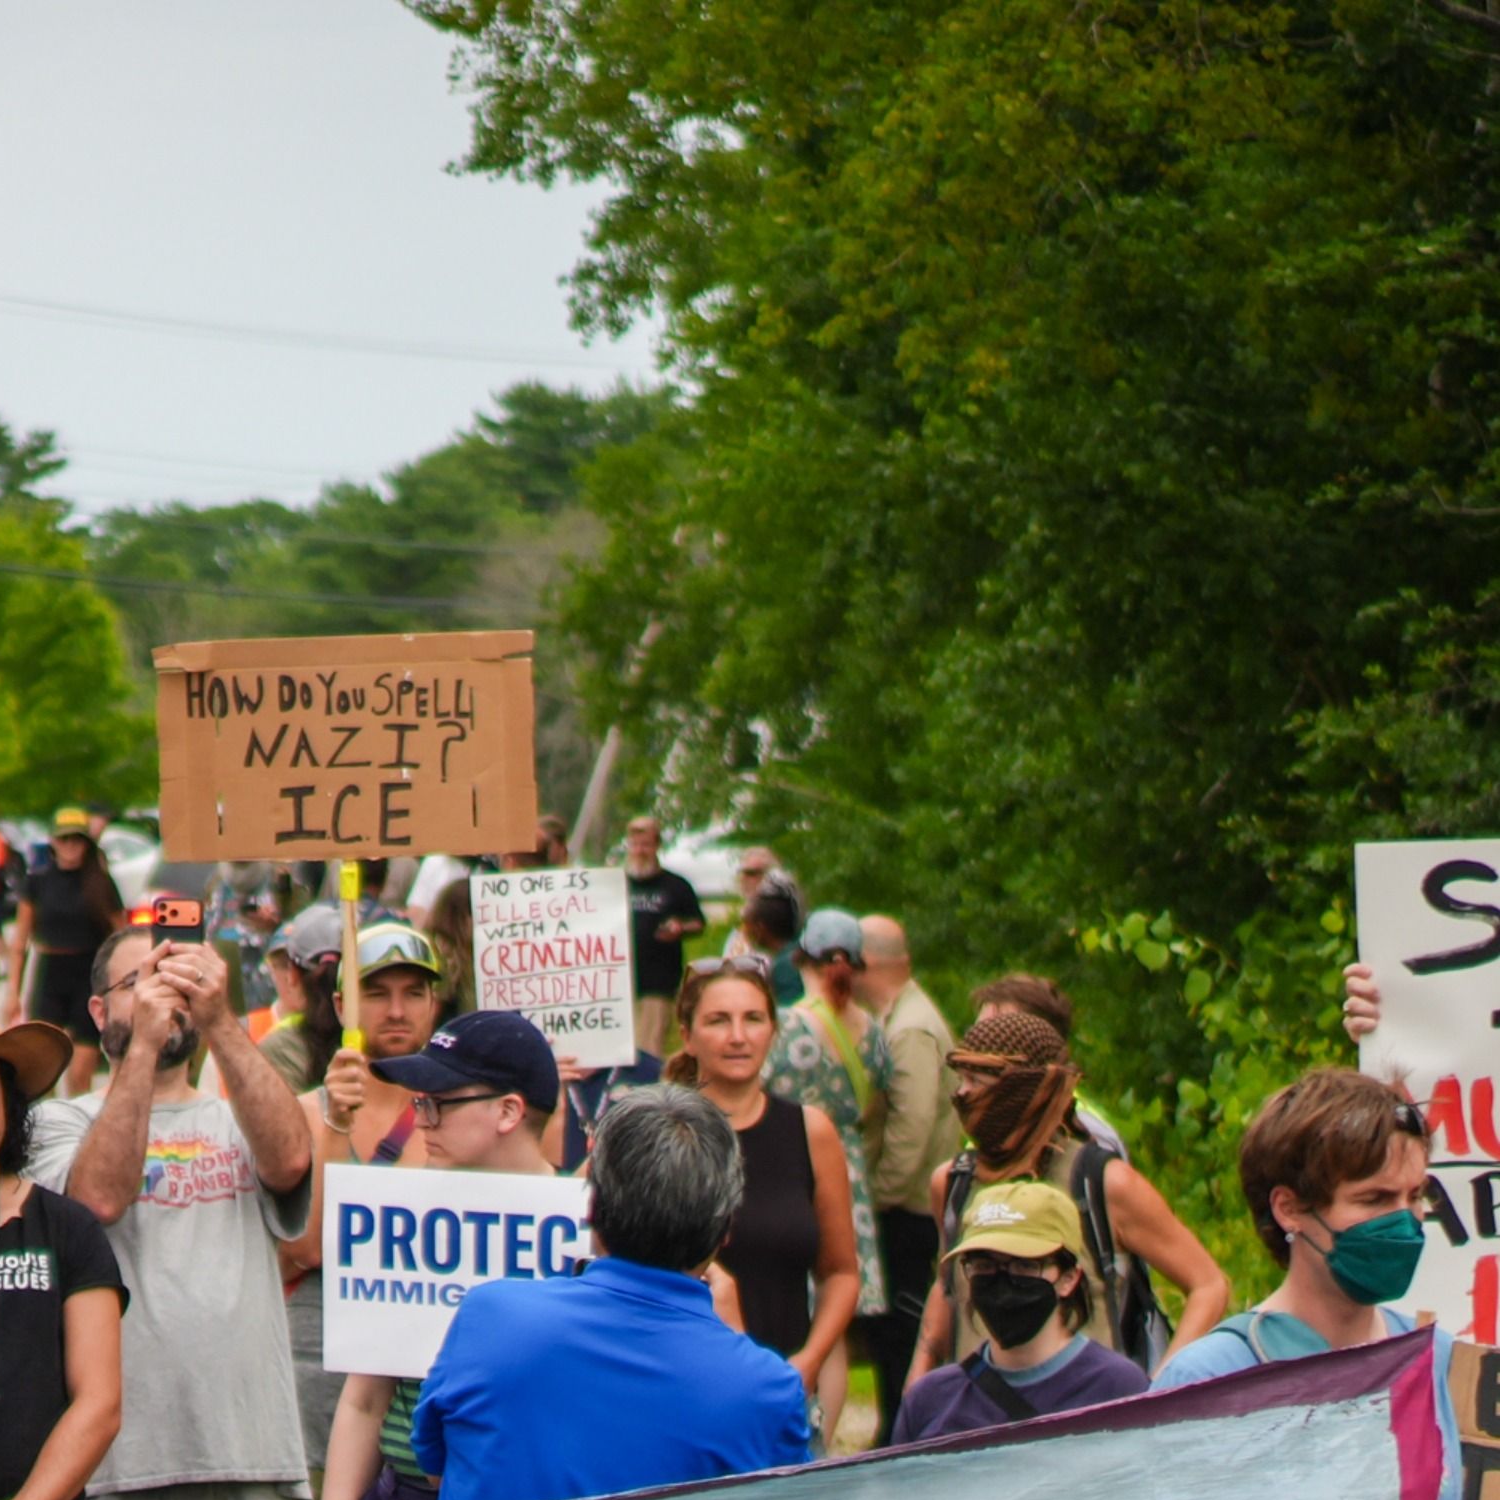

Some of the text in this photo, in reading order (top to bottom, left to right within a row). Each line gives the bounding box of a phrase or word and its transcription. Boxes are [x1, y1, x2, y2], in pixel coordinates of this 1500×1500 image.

[186, 671, 264, 719] HOW
[371, 672, 473, 720] SPELL
[244, 721, 467, 783] NAZI?
[481, 871, 590, 898] NO ONE IS
[477, 895, 598, 924] ILLEGAL
[483, 919, 570, 941] WITH A
[480, 933, 626, 978] CRIMINAL
[482, 968, 618, 1009] PRESIDENT
[338, 1202, 592, 1279] PROTEC
[339, 1276, 467, 1308] IMMIG
